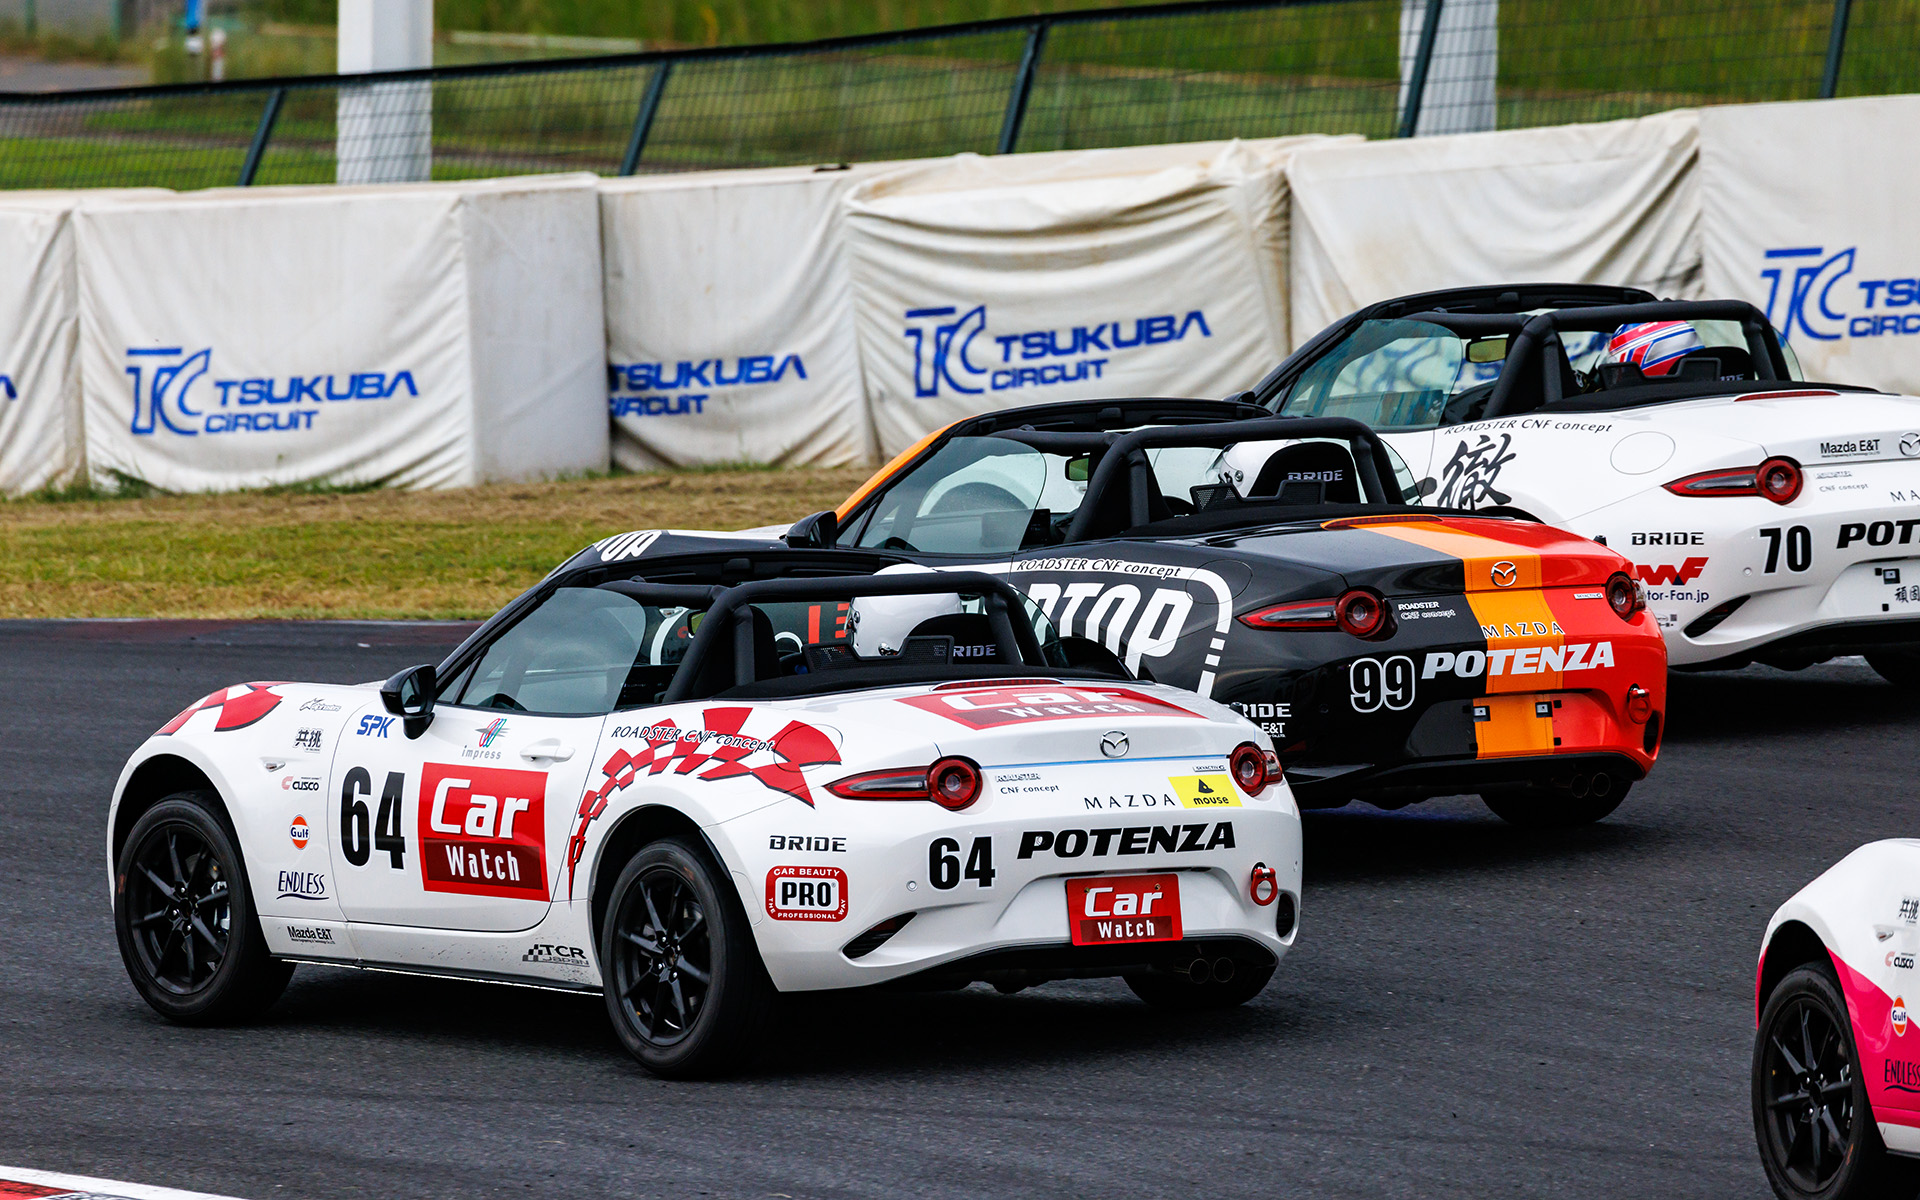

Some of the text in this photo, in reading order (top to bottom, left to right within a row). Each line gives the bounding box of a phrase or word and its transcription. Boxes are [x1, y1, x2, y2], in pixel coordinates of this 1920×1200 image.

[1858, 278, 1920, 309] TS
[995, 310, 1212, 362] TSUKUBA
[214, 370, 419, 407] TSUKUBA
[1445, 418, 1613, 435] ROADSTER CNF concept
[1820, 439, 1880, 454] Mazda E&T
[1838, 483, 1869, 491] concept
[1631, 532, 1705, 545] BRIDE
[1760, 525, 1812, 574] 70
[1016, 559, 1181, 578] ROADSTER CNF concept
[1646, 589, 1709, 602] tor-Fan.jp
[1398, 602, 1440, 610] ROADSTER
[1482, 622, 1565, 638] MAZDA
[1421, 641, 1615, 679] POTENZA
[1350, 656, 1415, 713] 99
[940, 689, 1124, 711] Car
[998, 702, 1145, 718] Watch
[356, 714, 396, 738] SPK
[611, 726, 775, 753] ROADSTER CNF concept
[462, 746, 501, 759] impress
[292, 781, 319, 791] CUSCO
[1000, 786, 1019, 794] CNF
[430, 777, 529, 839] Car
[1085, 793, 1176, 809] MAZDA
[1193, 796, 1229, 805] mouse
[340, 766, 406, 870] 64
[290, 828, 309, 838] Gulf
[1017, 821, 1236, 860] POTENZA
[769, 835, 846, 852] BRIDE
[445, 845, 520, 881] Watch
[928, 837, 996, 889] 64
[773, 868, 795, 876] CAR
[278, 871, 325, 894] ENDLESS
[781, 882, 832, 907] PRO
[1084, 886, 1163, 917] Car
[768, 898, 776, 914] THE
[838, 899, 846, 915] WAY
[287, 926, 333, 940] Mazda E&T
[1097, 919, 1156, 938] Watch
[539, 944, 587, 959] TCR
[1892, 1010, 1907, 1022] Gulf
